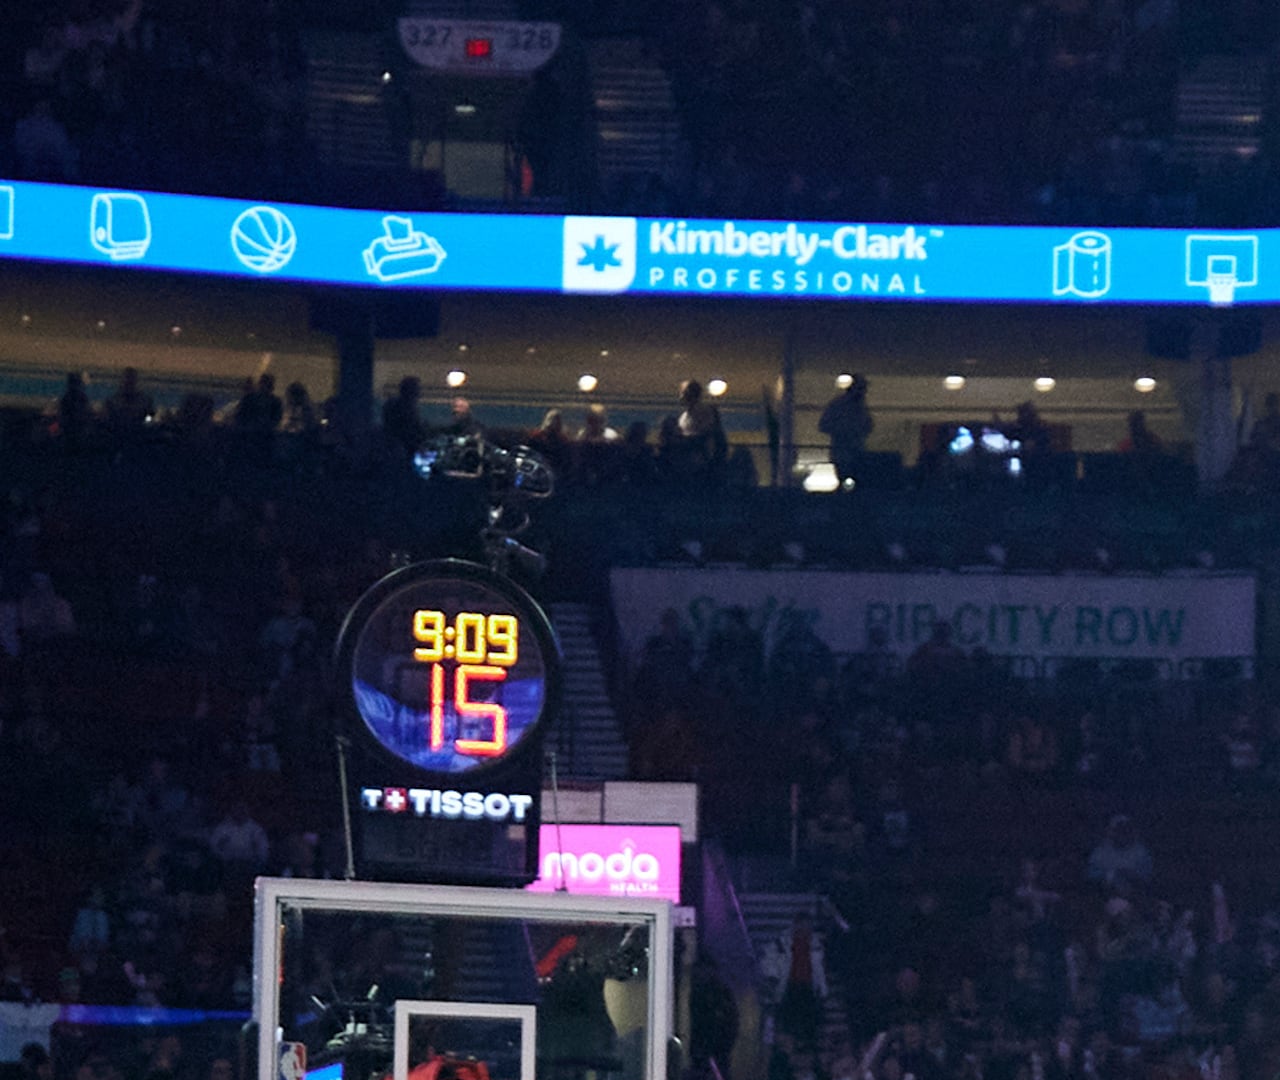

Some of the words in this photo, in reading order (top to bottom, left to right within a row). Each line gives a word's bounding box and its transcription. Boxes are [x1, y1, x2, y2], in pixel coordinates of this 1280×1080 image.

[649, 266, 926, 294] PROFESSIONAL
[413, 609, 518, 666] 9:09
[955, 603, 1061, 646] CITY
[1075, 606, 1186, 648] ROW
[429, 662, 507, 757] 15
[408, 788, 533, 820] TISSOT
[543, 847, 660, 881] moda
